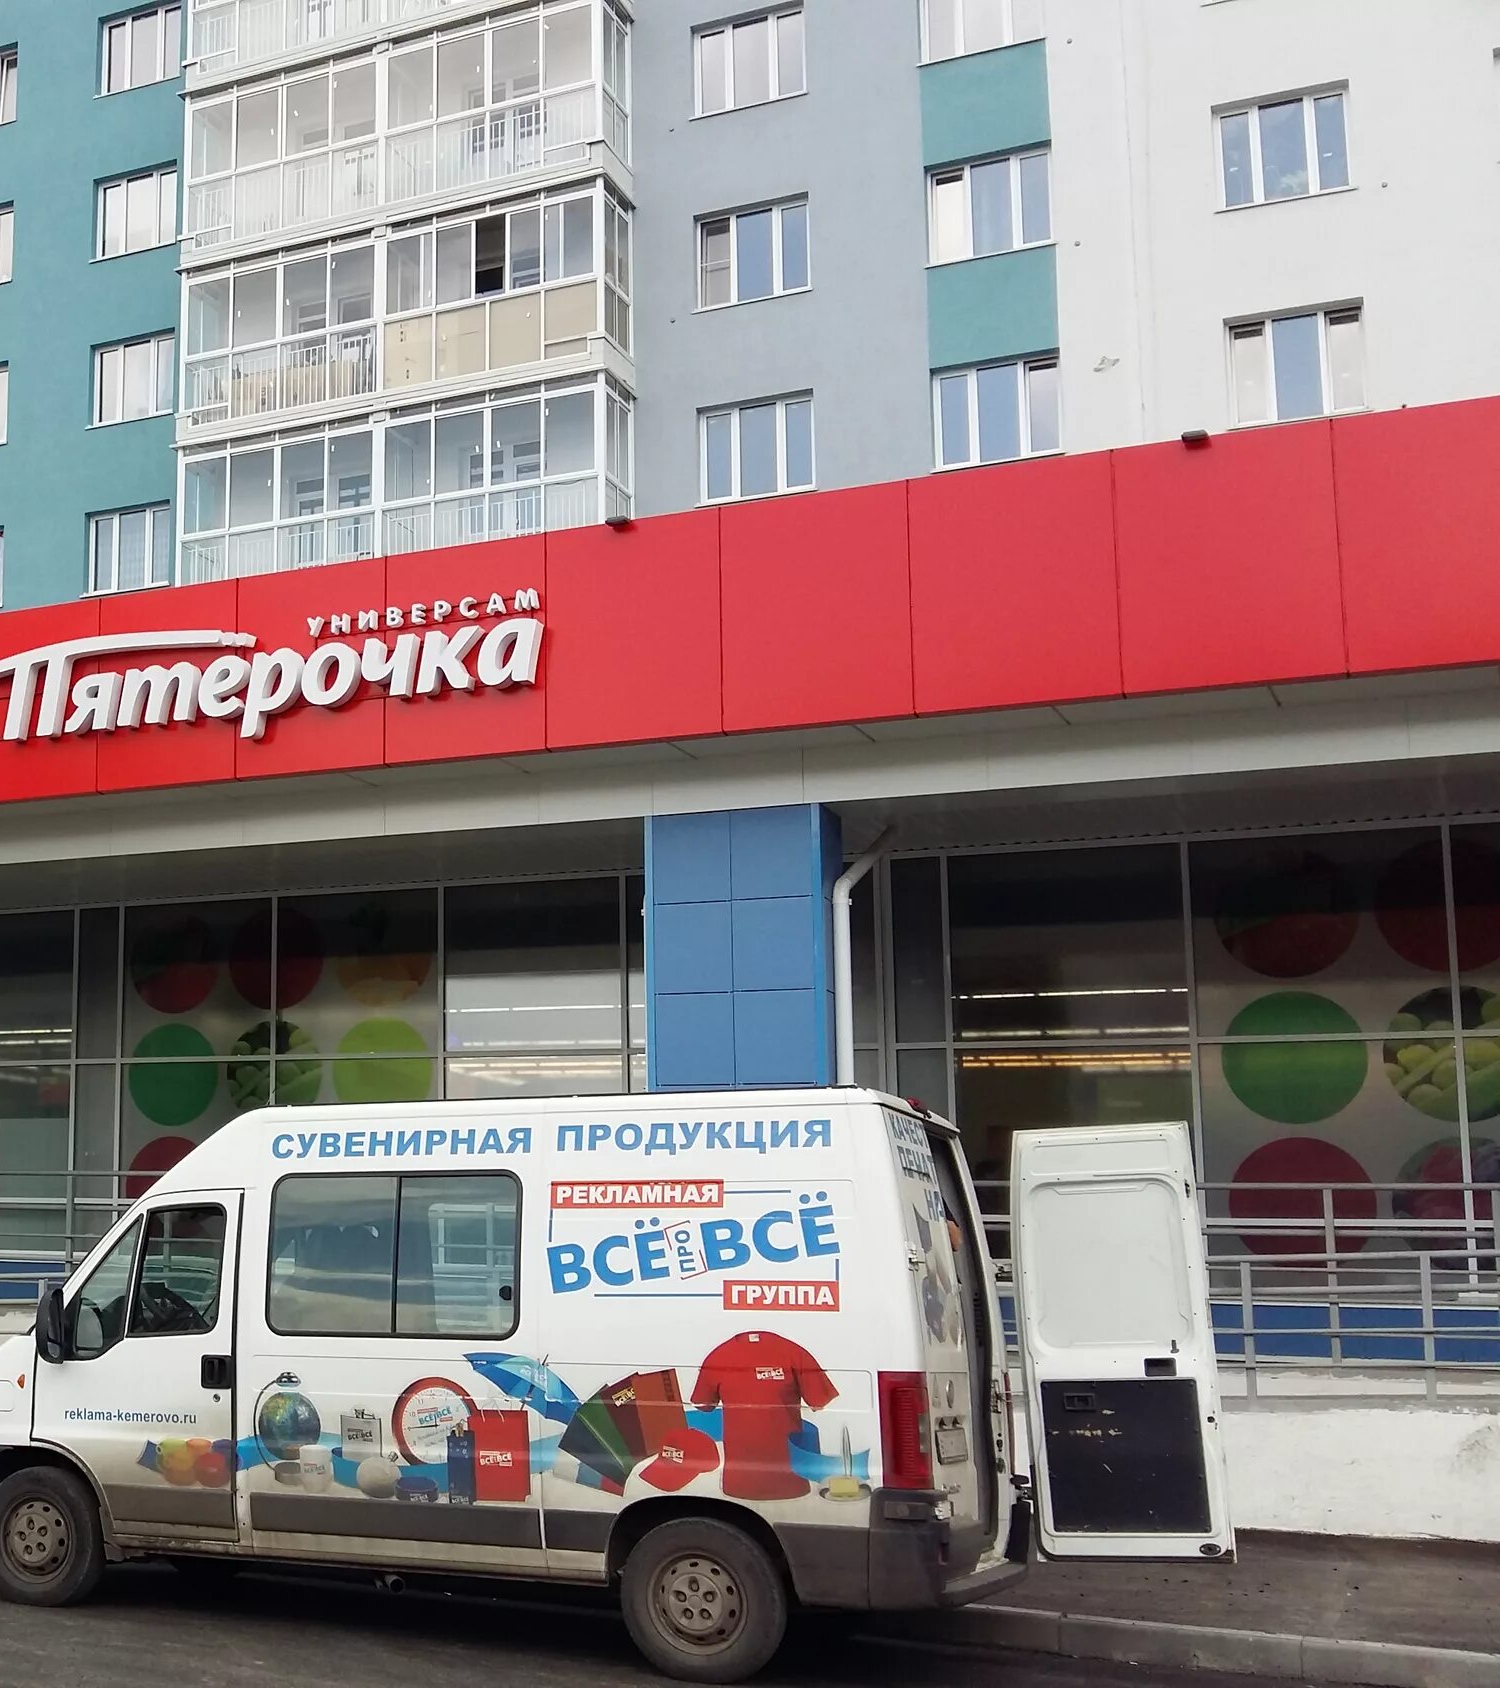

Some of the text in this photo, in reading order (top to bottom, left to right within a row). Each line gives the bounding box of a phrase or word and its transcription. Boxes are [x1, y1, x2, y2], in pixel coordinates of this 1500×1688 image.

[307, 588, 540, 637] УНИВЕРСАМ
[271, 1119, 833, 1160] СУВЕНИРНАЯ ПРОДУКЦИЯ
[556, 1183, 719, 1205] РЕКЛАМНАЯ
[546, 1190, 841, 1294] ВСЁ ПРО ВСЁ
[731, 1285, 835, 1306] ГРУППА
[64, 1407, 197, 1425] reklama-kemerovo.ru
